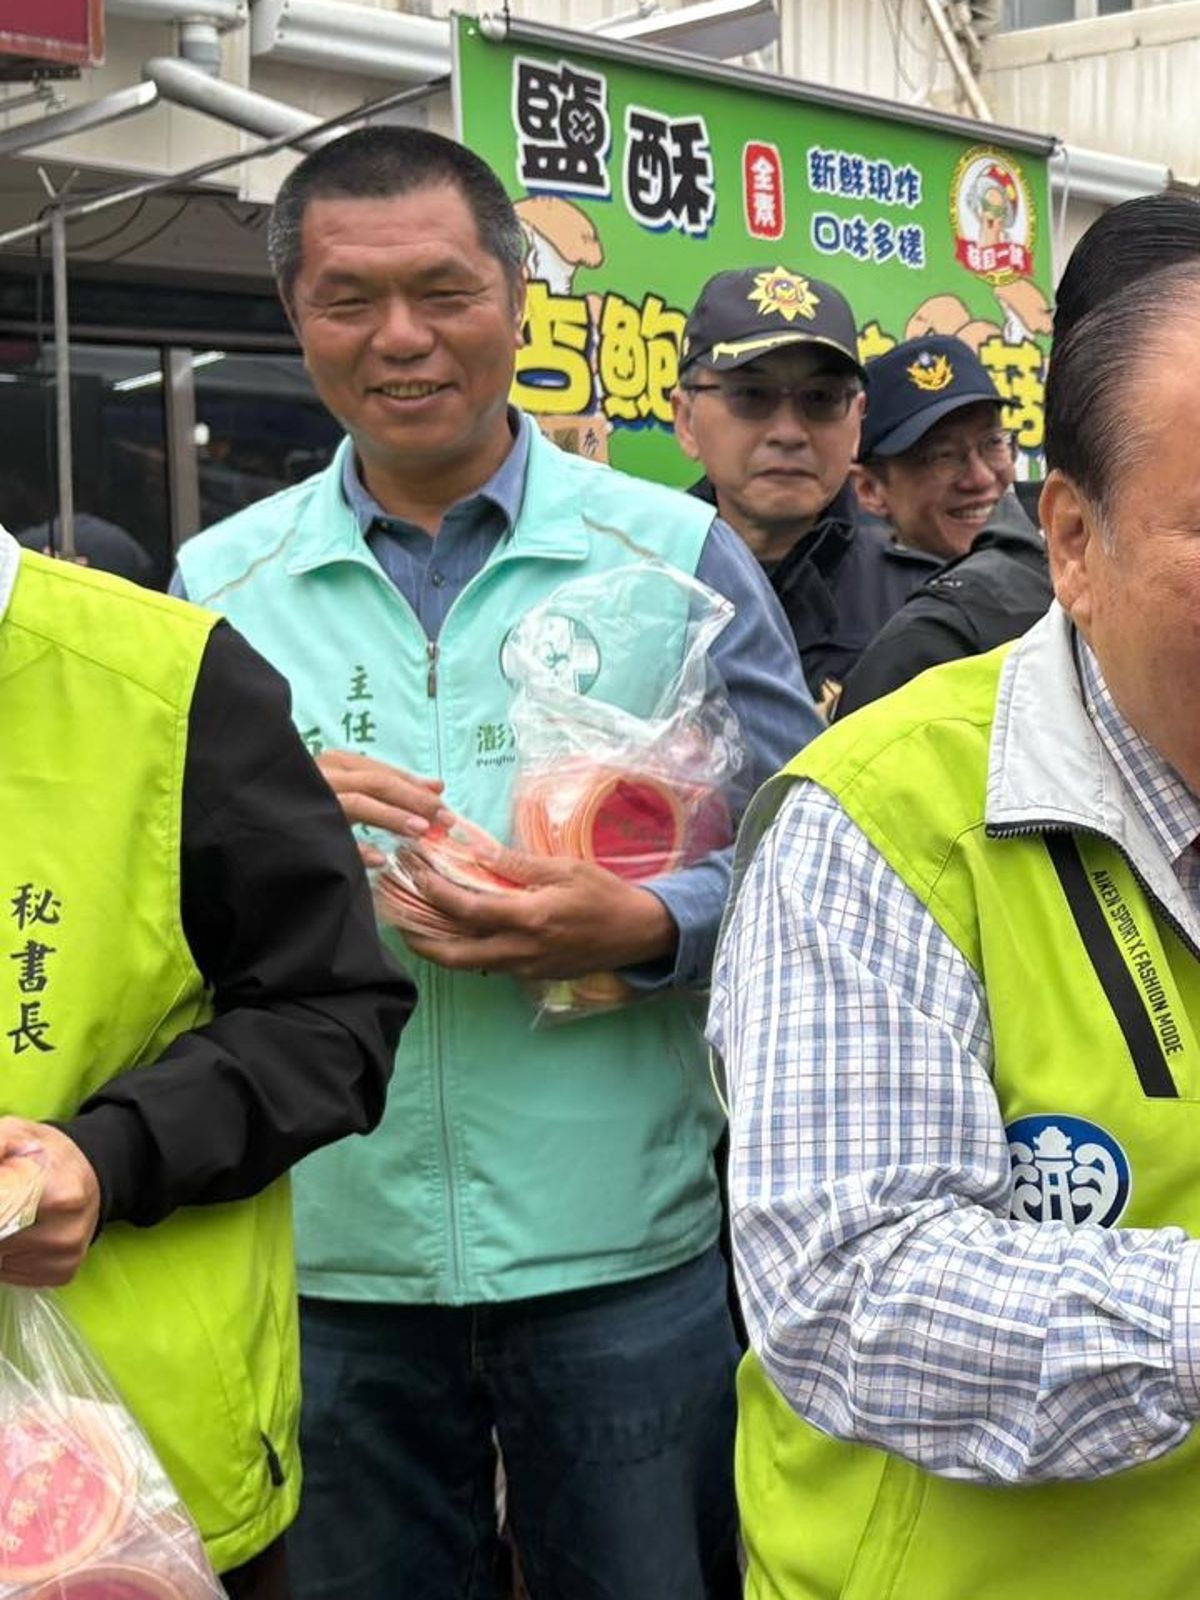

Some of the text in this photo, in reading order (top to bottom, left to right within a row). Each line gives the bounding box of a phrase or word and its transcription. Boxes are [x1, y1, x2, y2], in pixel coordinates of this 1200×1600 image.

[517, 62, 713, 226] 鹽酥
[809, 149, 920, 206] 新鮮現炸
[750, 156, 776, 228] 全素
[813, 214, 922, 266] 口味多樣
[341, 665, 376, 743] 主任
[7, 883, 62, 1054] 秘書長
[1091, 869, 1184, 1056] AIKEN SPORT X FASHION MODE
